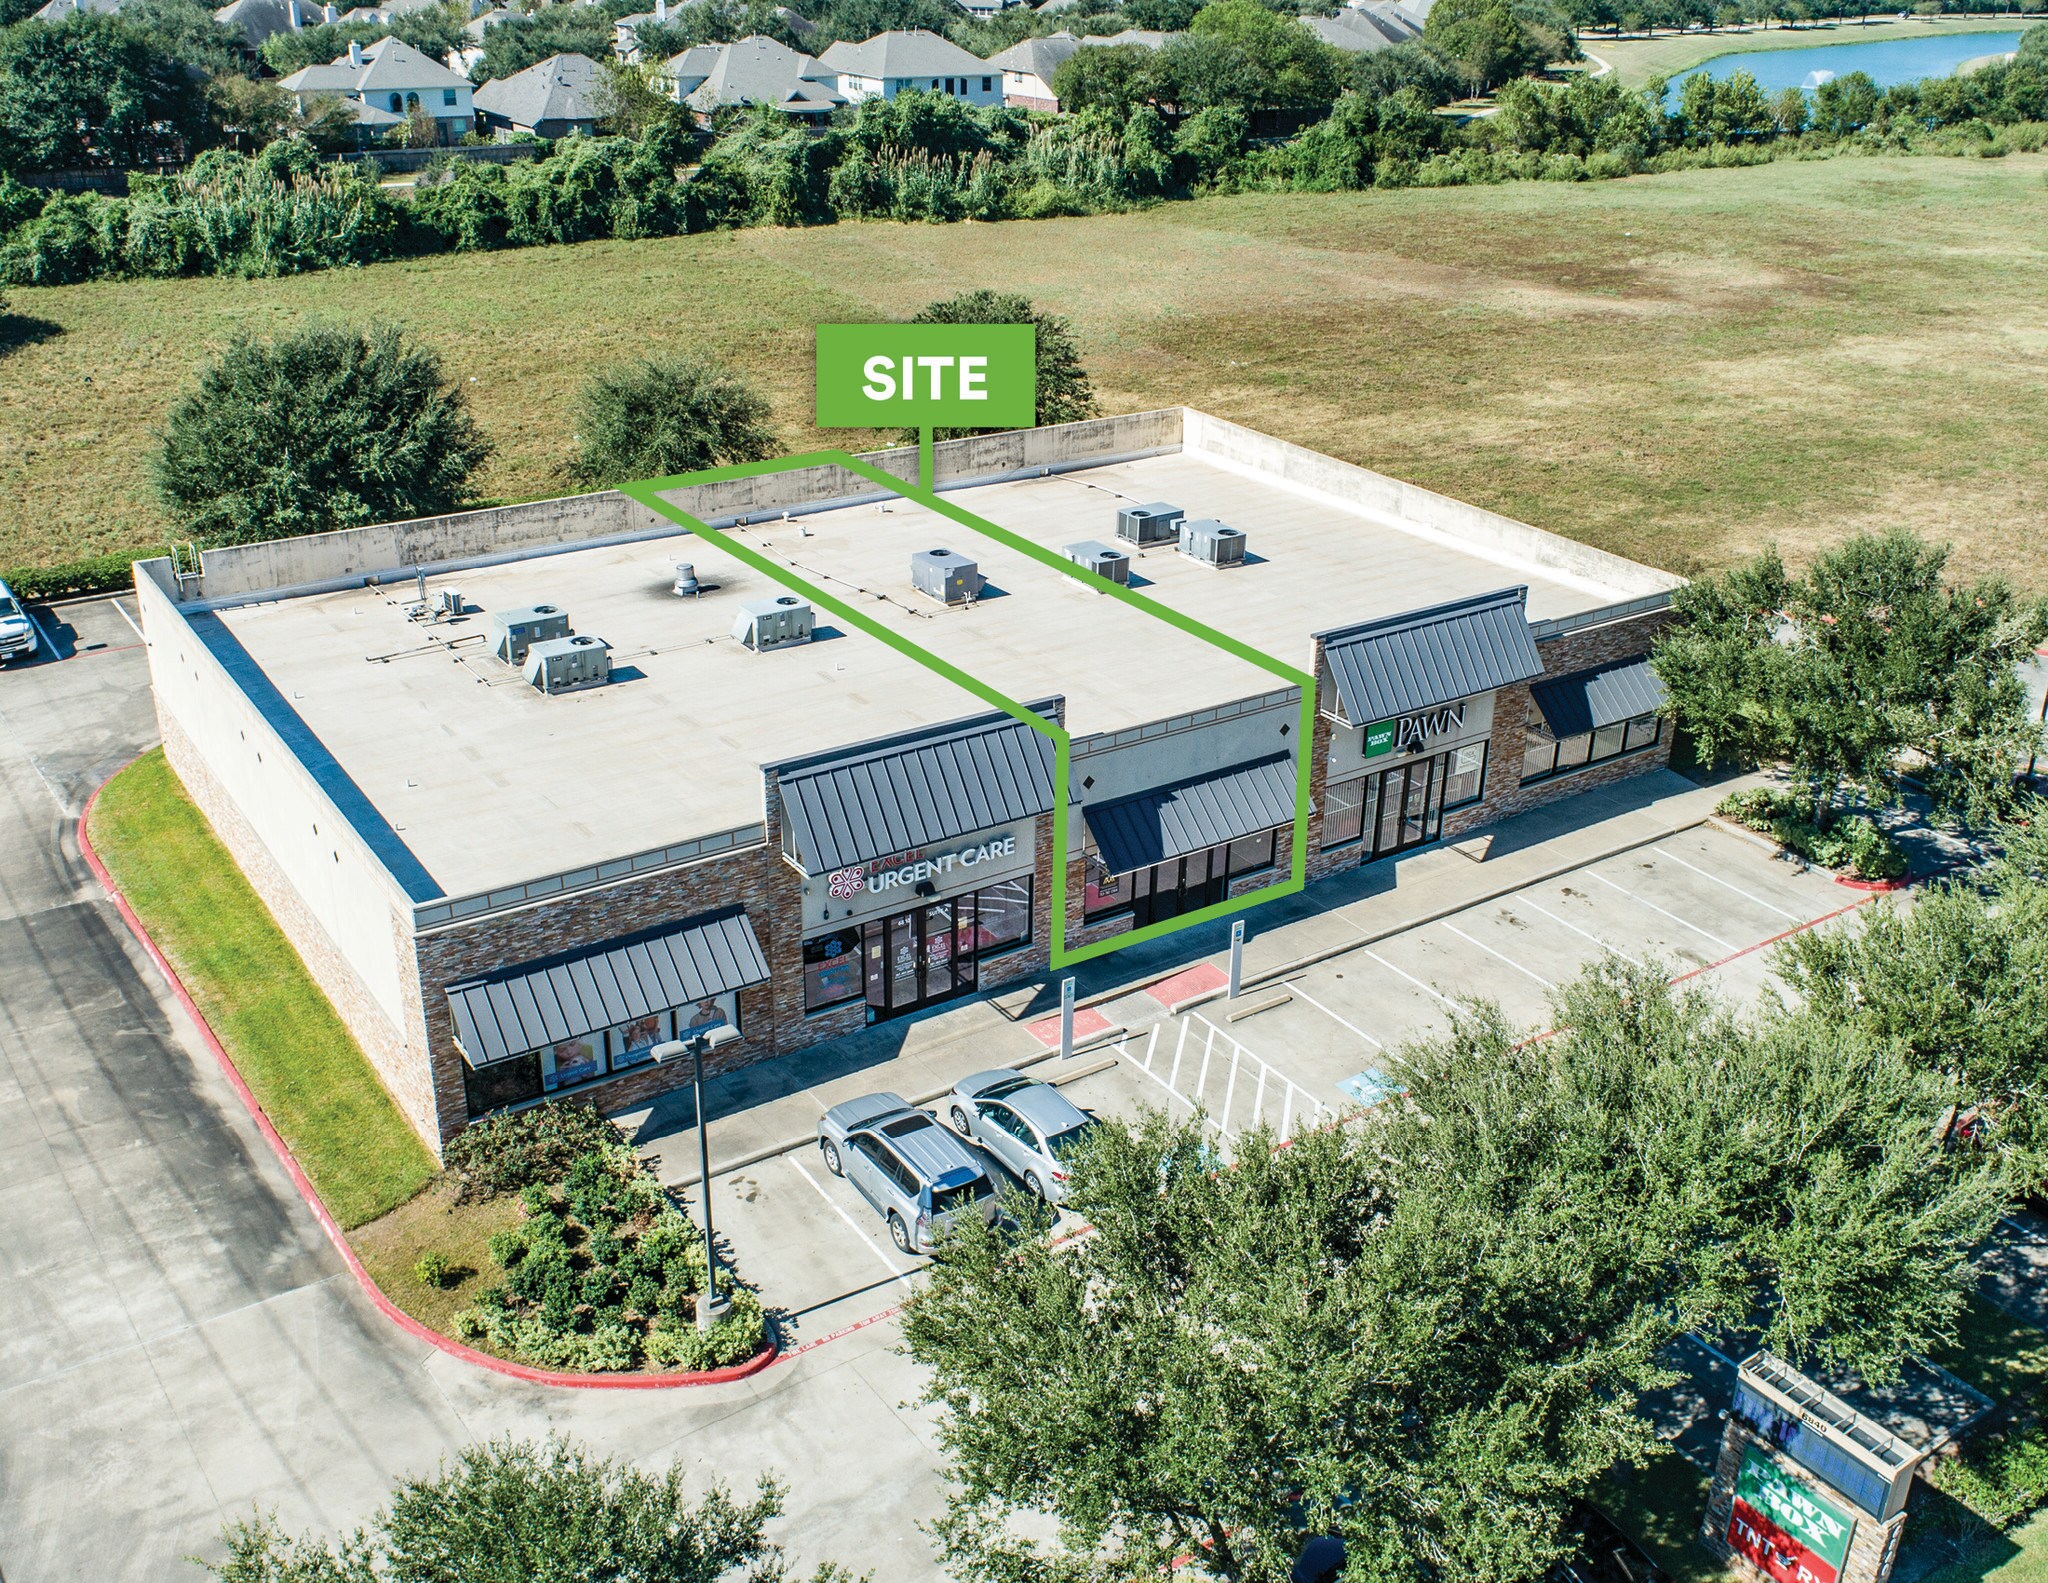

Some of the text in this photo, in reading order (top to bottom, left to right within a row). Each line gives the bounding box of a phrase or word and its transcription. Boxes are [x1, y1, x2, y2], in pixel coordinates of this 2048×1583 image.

[1396, 704, 1466, 747] PAWN
[868, 837, 1016, 894] URGENT CARE
[870, 848, 925, 872] EXCEL
[1801, 1412, 1827, 1433] 6840
[1748, 1458, 1847, 1539] PAWN
[1755, 1482, 1829, 1548] BOX
[1736, 1517, 1775, 1555] TNT
